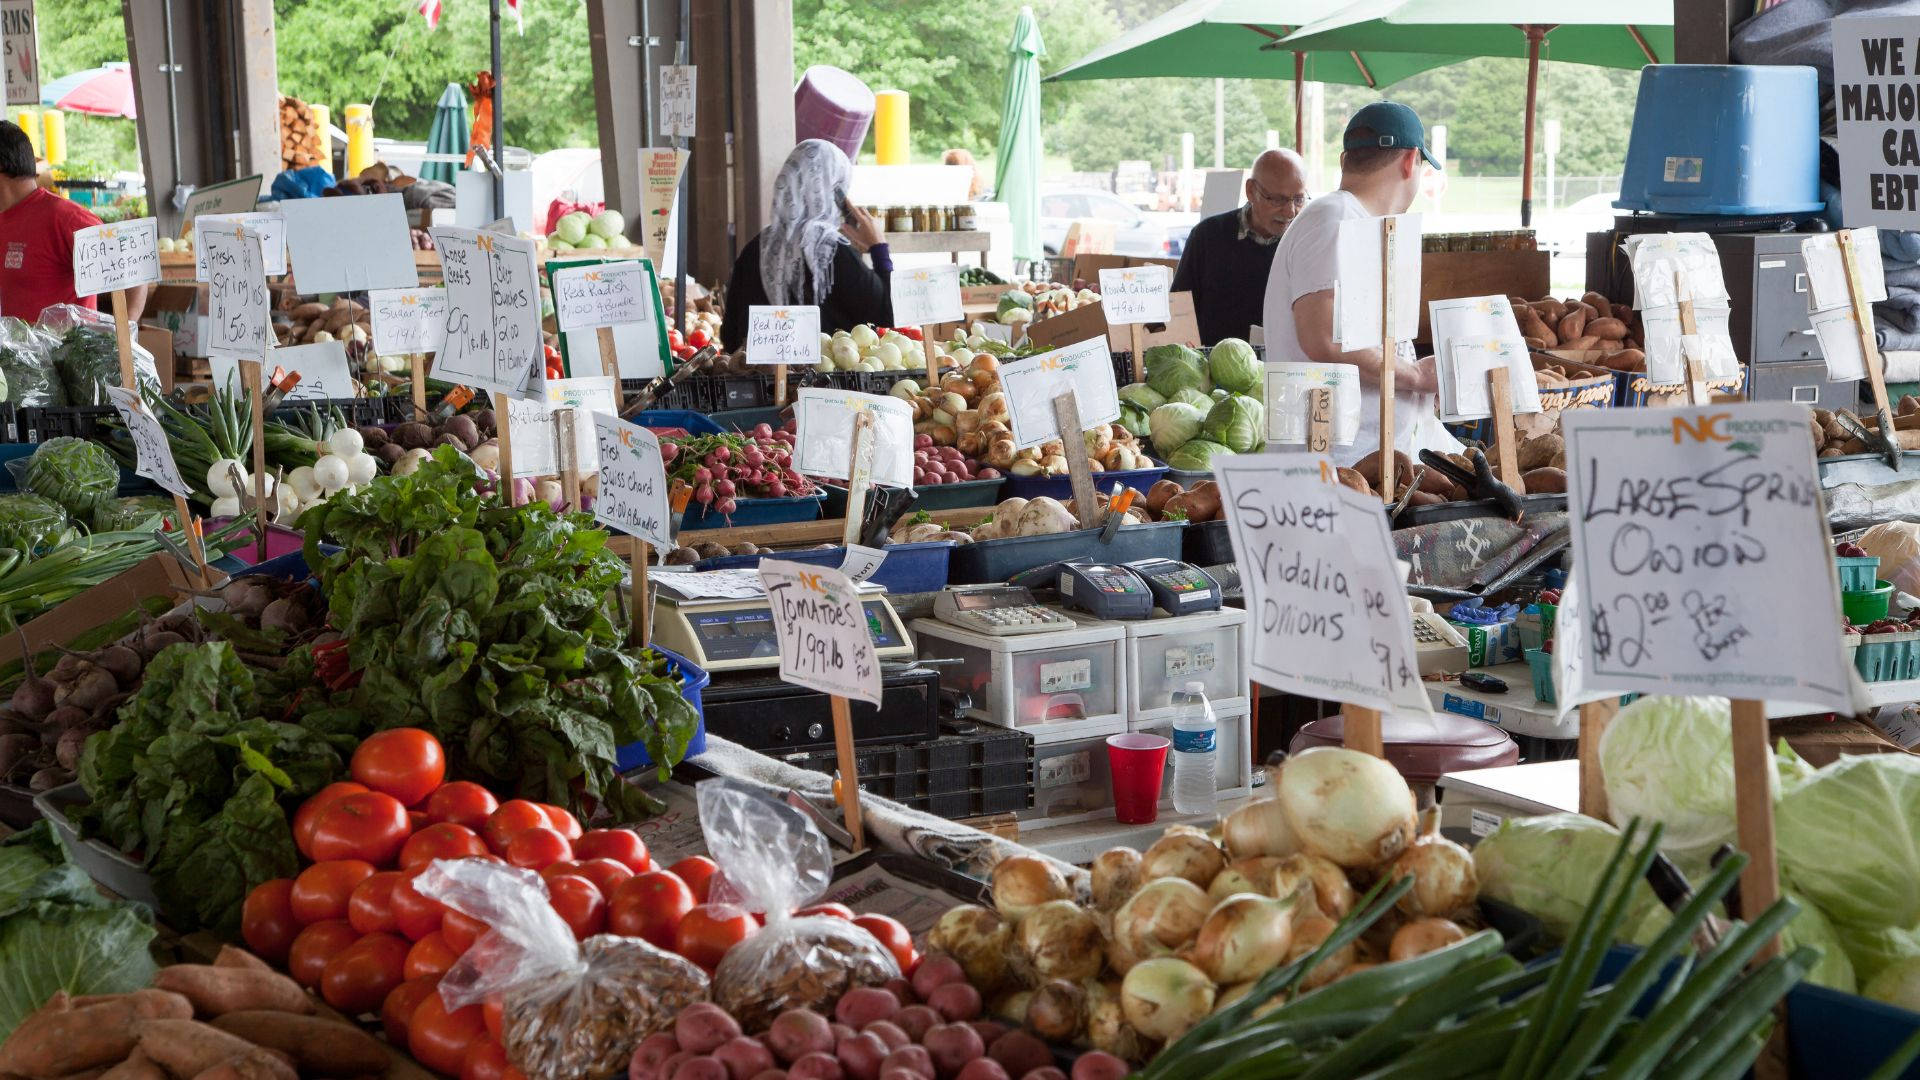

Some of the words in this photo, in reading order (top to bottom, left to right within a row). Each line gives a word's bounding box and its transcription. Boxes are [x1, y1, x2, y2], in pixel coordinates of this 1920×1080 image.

[1862, 37, 1906, 76] WE
[1841, 83, 1920, 122] MAJO
[1870, 173, 1919, 211] EBT
[752, 316, 770, 333] Red
[1060, 350, 1092, 363] PRODUCTS
[868, 403, 901, 416] PRODUCTS
[618, 426, 634, 449] NC
[1671, 413, 1733, 445] NC
[1725, 418, 1789, 435] PRODUCTS
[601, 465, 625, 489] Swiss
[627, 470, 653, 497] Chard
[1236, 488, 1340, 534] Sweet
[798, 570, 828, 594] NC
[1251, 542, 1350, 598] Vidalia
